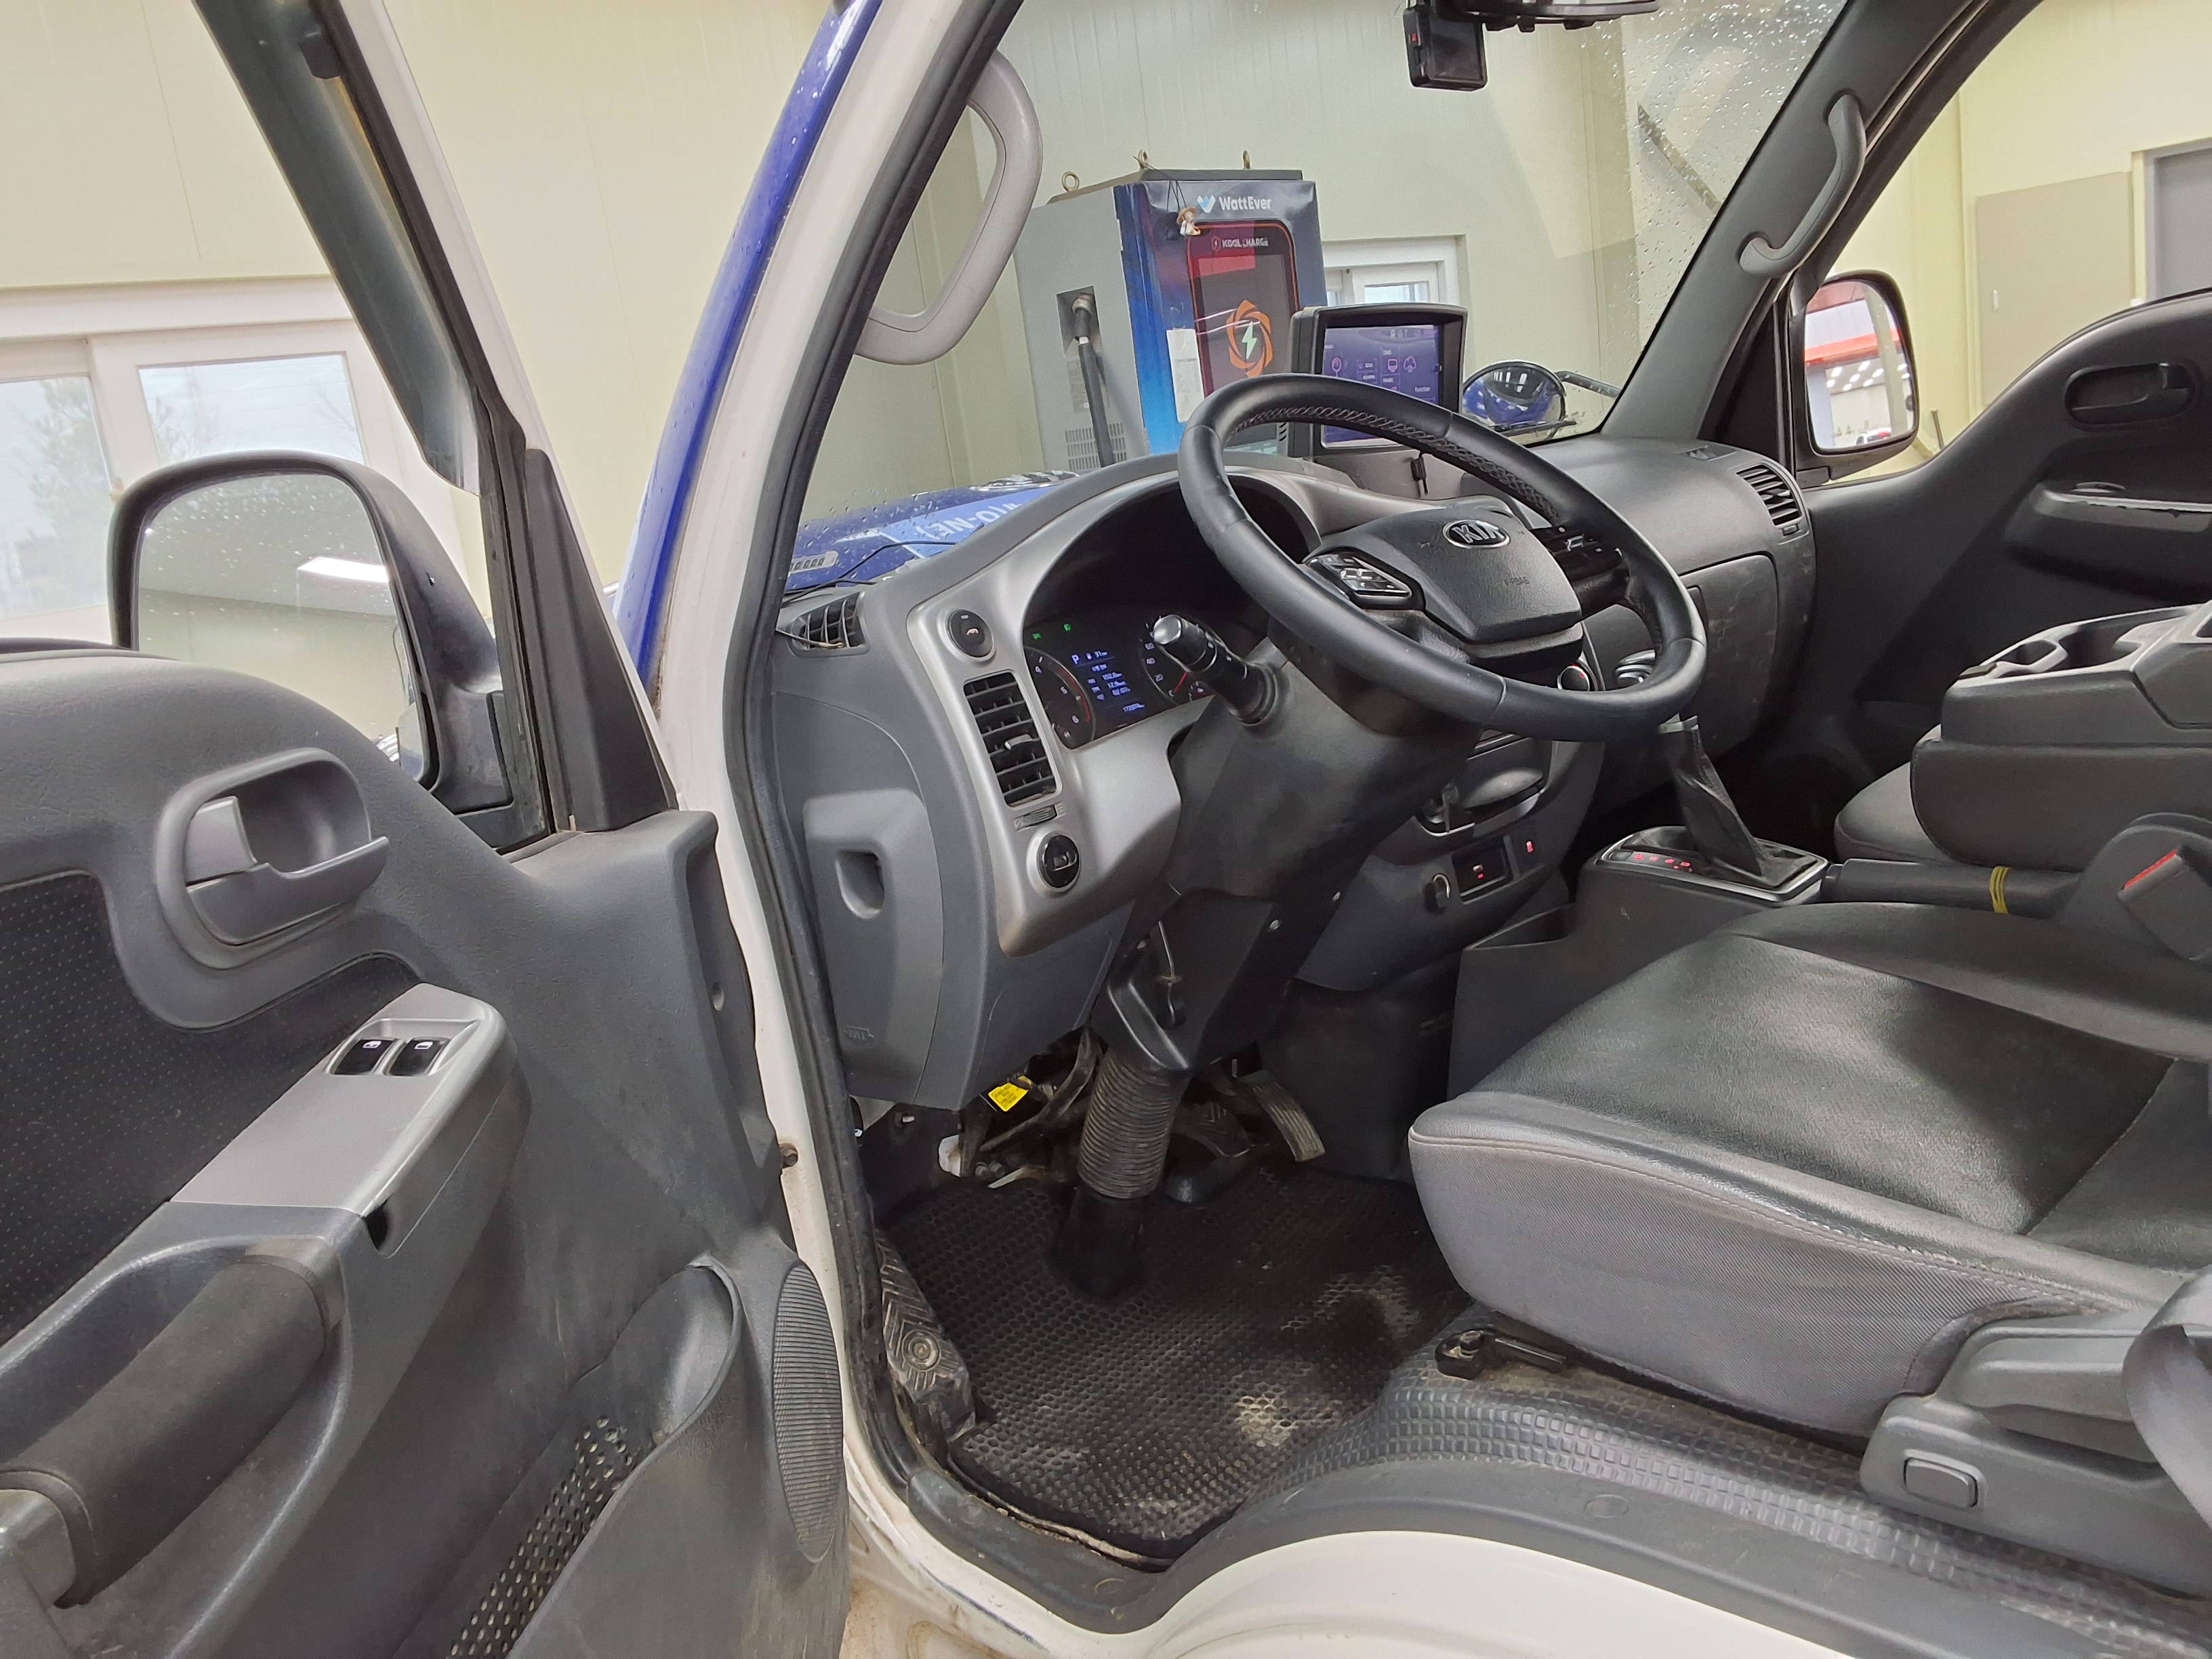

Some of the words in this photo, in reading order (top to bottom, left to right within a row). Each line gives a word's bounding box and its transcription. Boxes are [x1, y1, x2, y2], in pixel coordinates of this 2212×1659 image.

[1218, 196, 1271, 211] WattEver
[1450, 523, 1505, 544] KIA
[1071, 654, 1080, 665] P
[1071, 715, 1080, 724] 6
